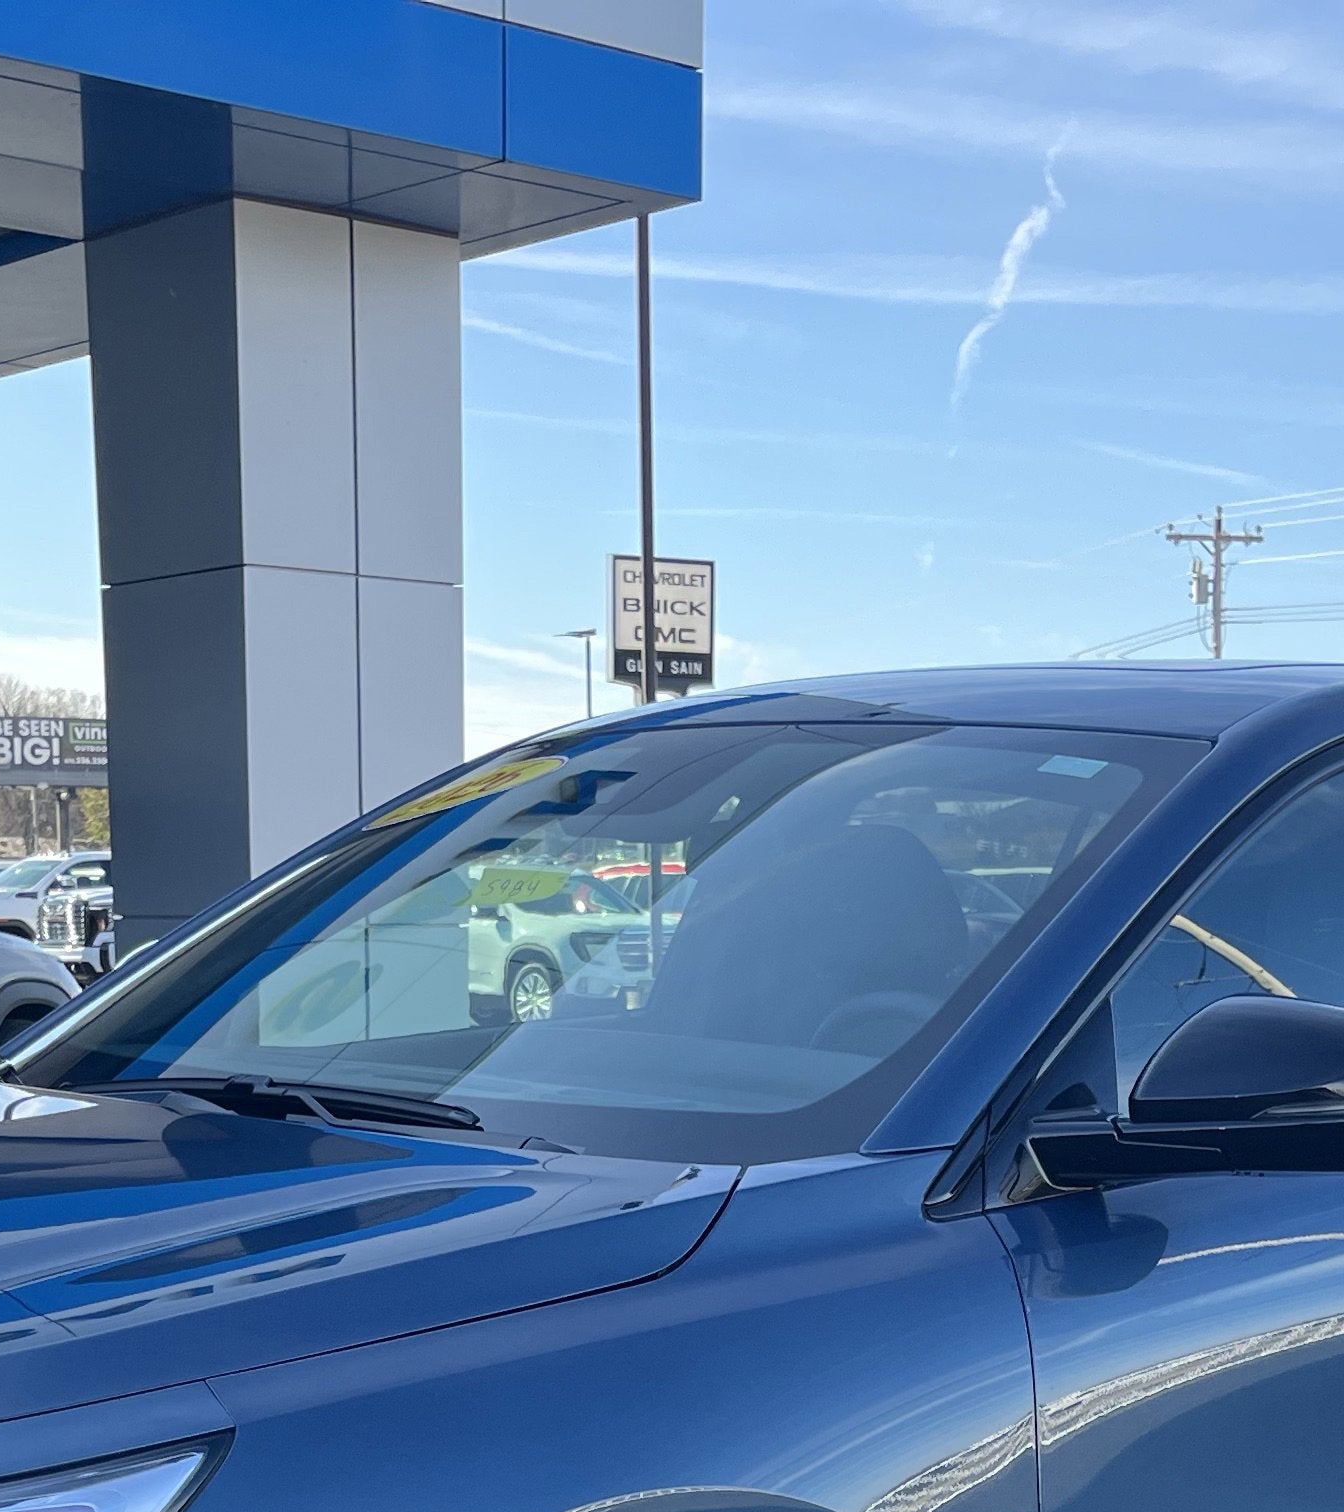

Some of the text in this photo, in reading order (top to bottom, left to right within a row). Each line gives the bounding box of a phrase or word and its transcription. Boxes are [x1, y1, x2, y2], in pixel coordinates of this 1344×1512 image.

[623, 570, 707, 588] CHVROLET
[625, 659, 703, 675] GLN SAIN
[18, 720, 64, 737] SEEN
[74, 745, 108, 753] OUTDOO
